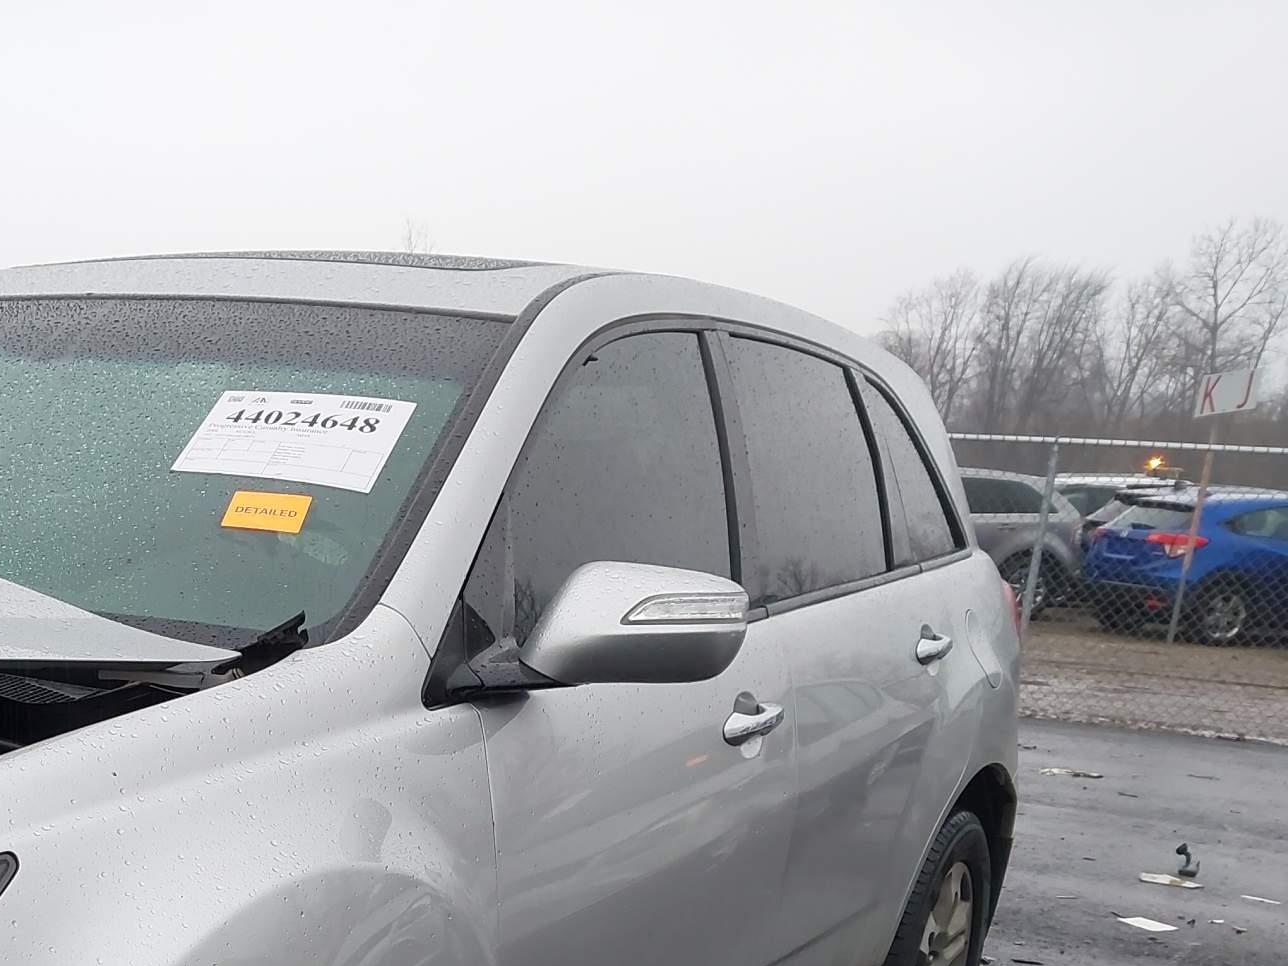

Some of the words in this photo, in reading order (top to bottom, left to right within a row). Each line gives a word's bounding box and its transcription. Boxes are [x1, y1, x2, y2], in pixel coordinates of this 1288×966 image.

[1199, 375, 1223, 415] K
[1236, 370, 1255, 409] J
[225, 408, 381, 433] 44024648
[234, 506, 298, 518] DETAILED
